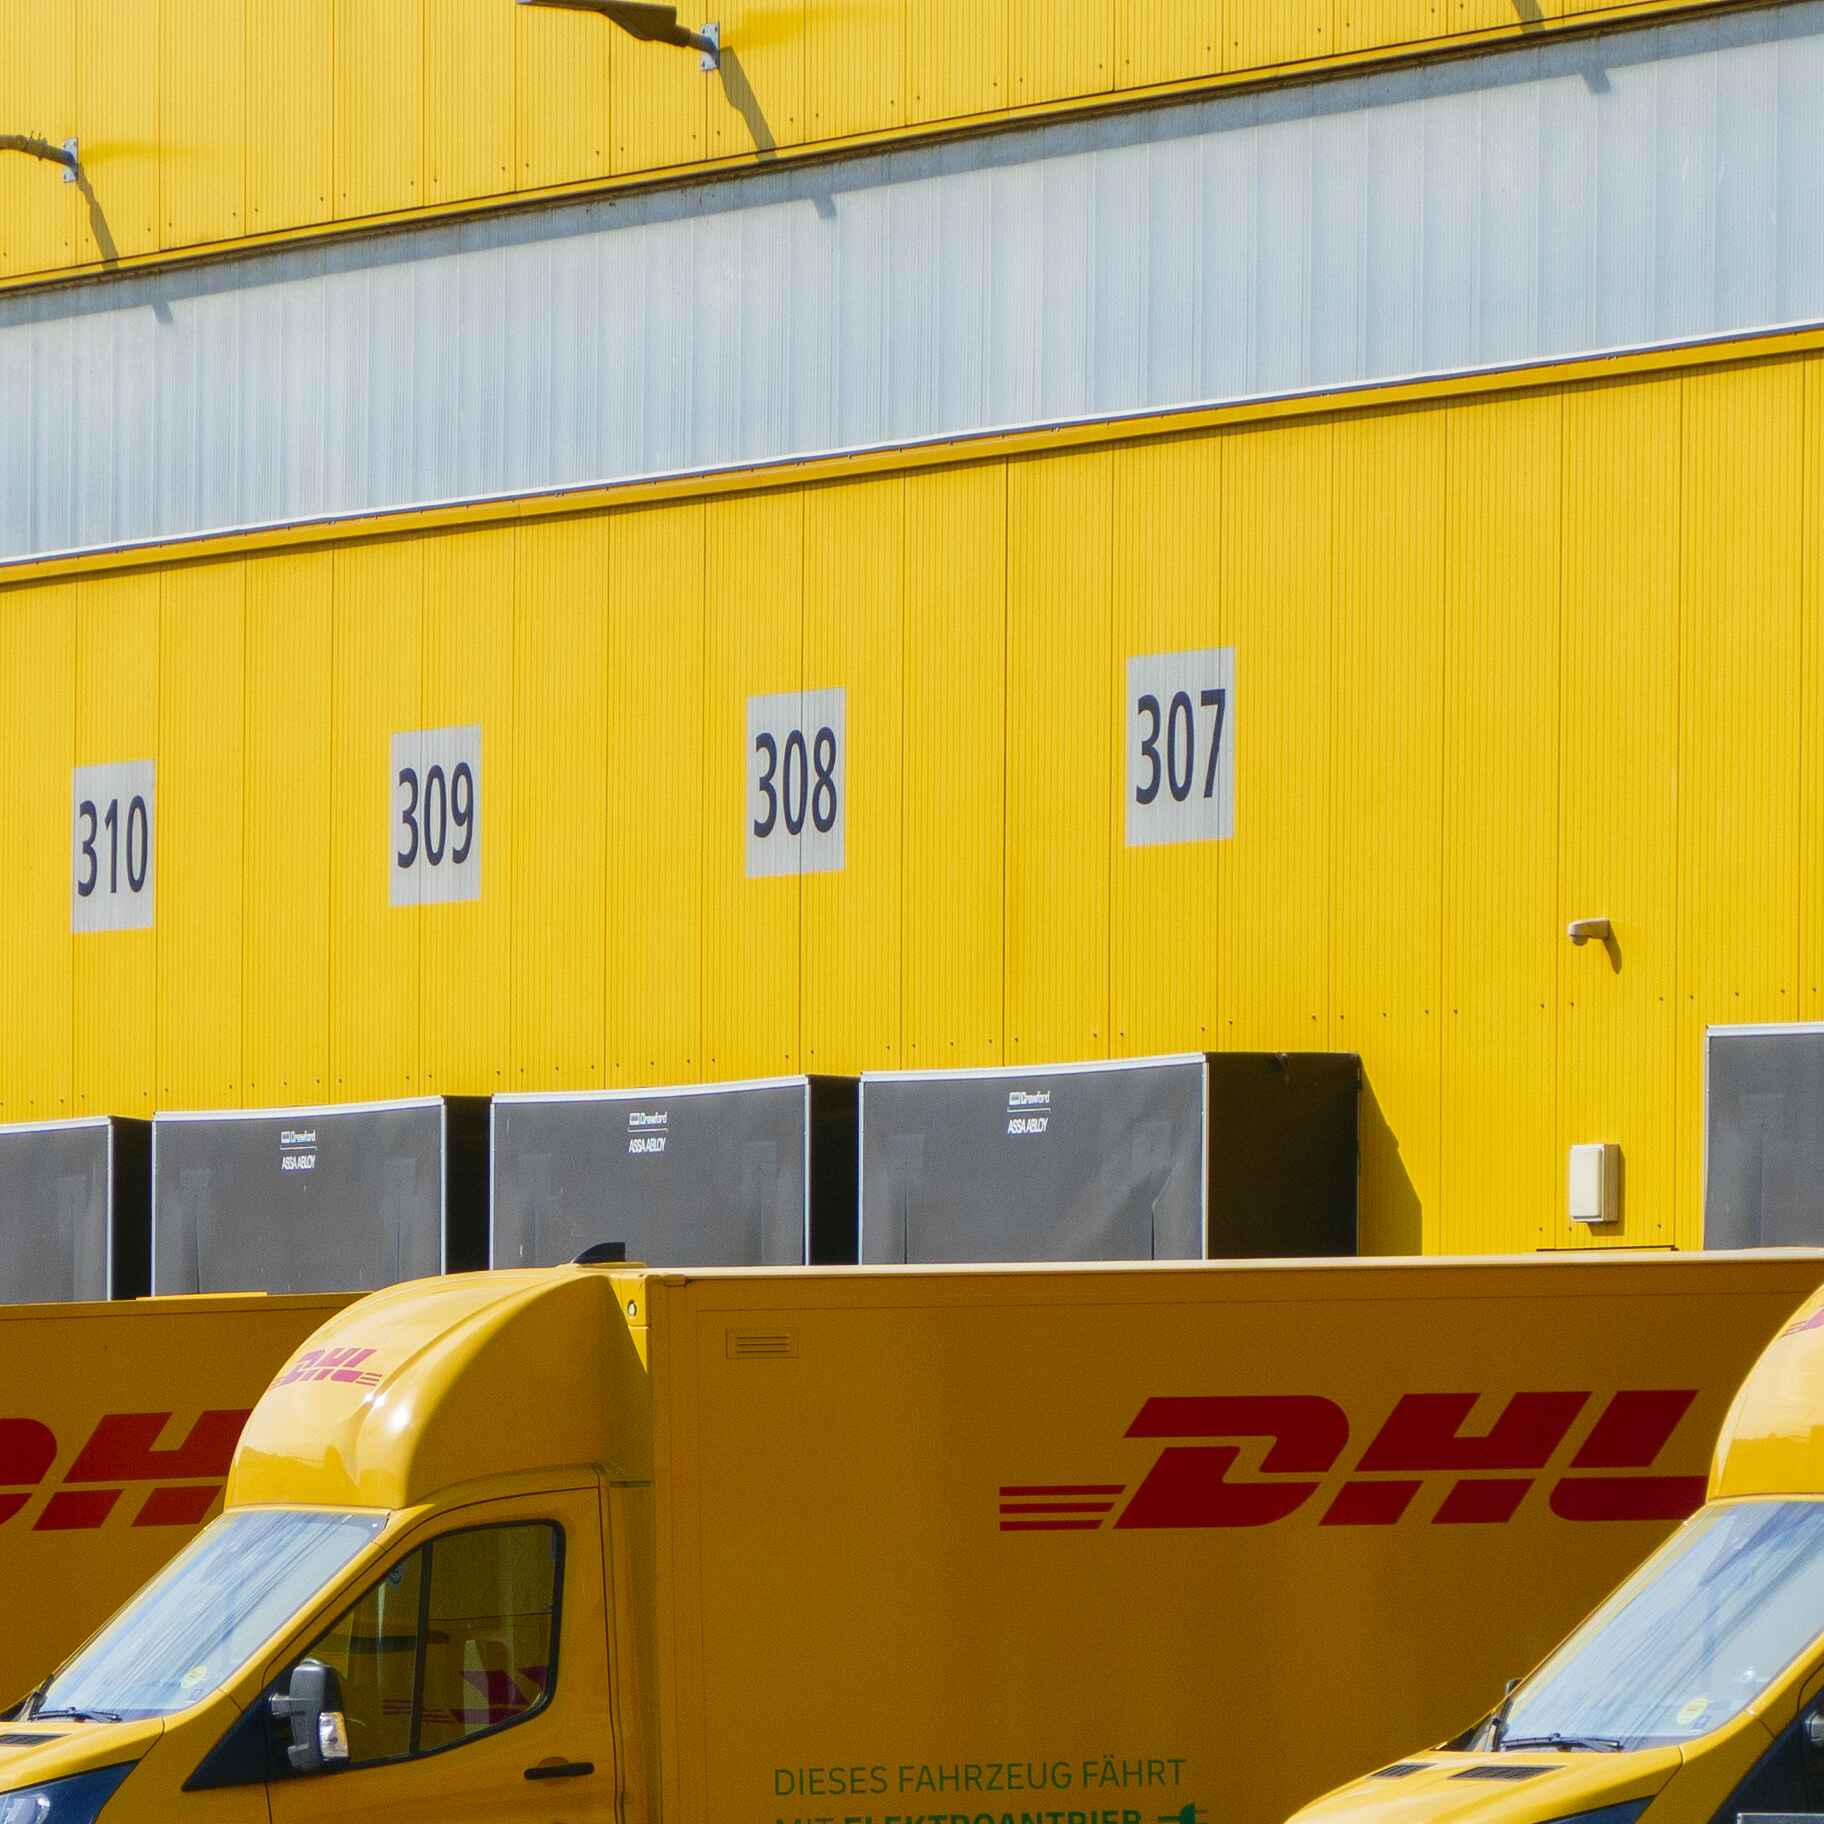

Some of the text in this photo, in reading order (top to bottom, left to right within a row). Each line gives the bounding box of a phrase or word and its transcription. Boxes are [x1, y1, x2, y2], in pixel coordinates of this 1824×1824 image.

[753, 726, 838, 839] 308
[1135, 688, 1226, 805] 307
[77, 795, 148, 898] 310
[397, 761, 474, 869] 309
[1111, 1389, 1708, 1530] DHL
[774, 1754, 1187, 1796] DIESES FAHRZEUG FÄHRT
